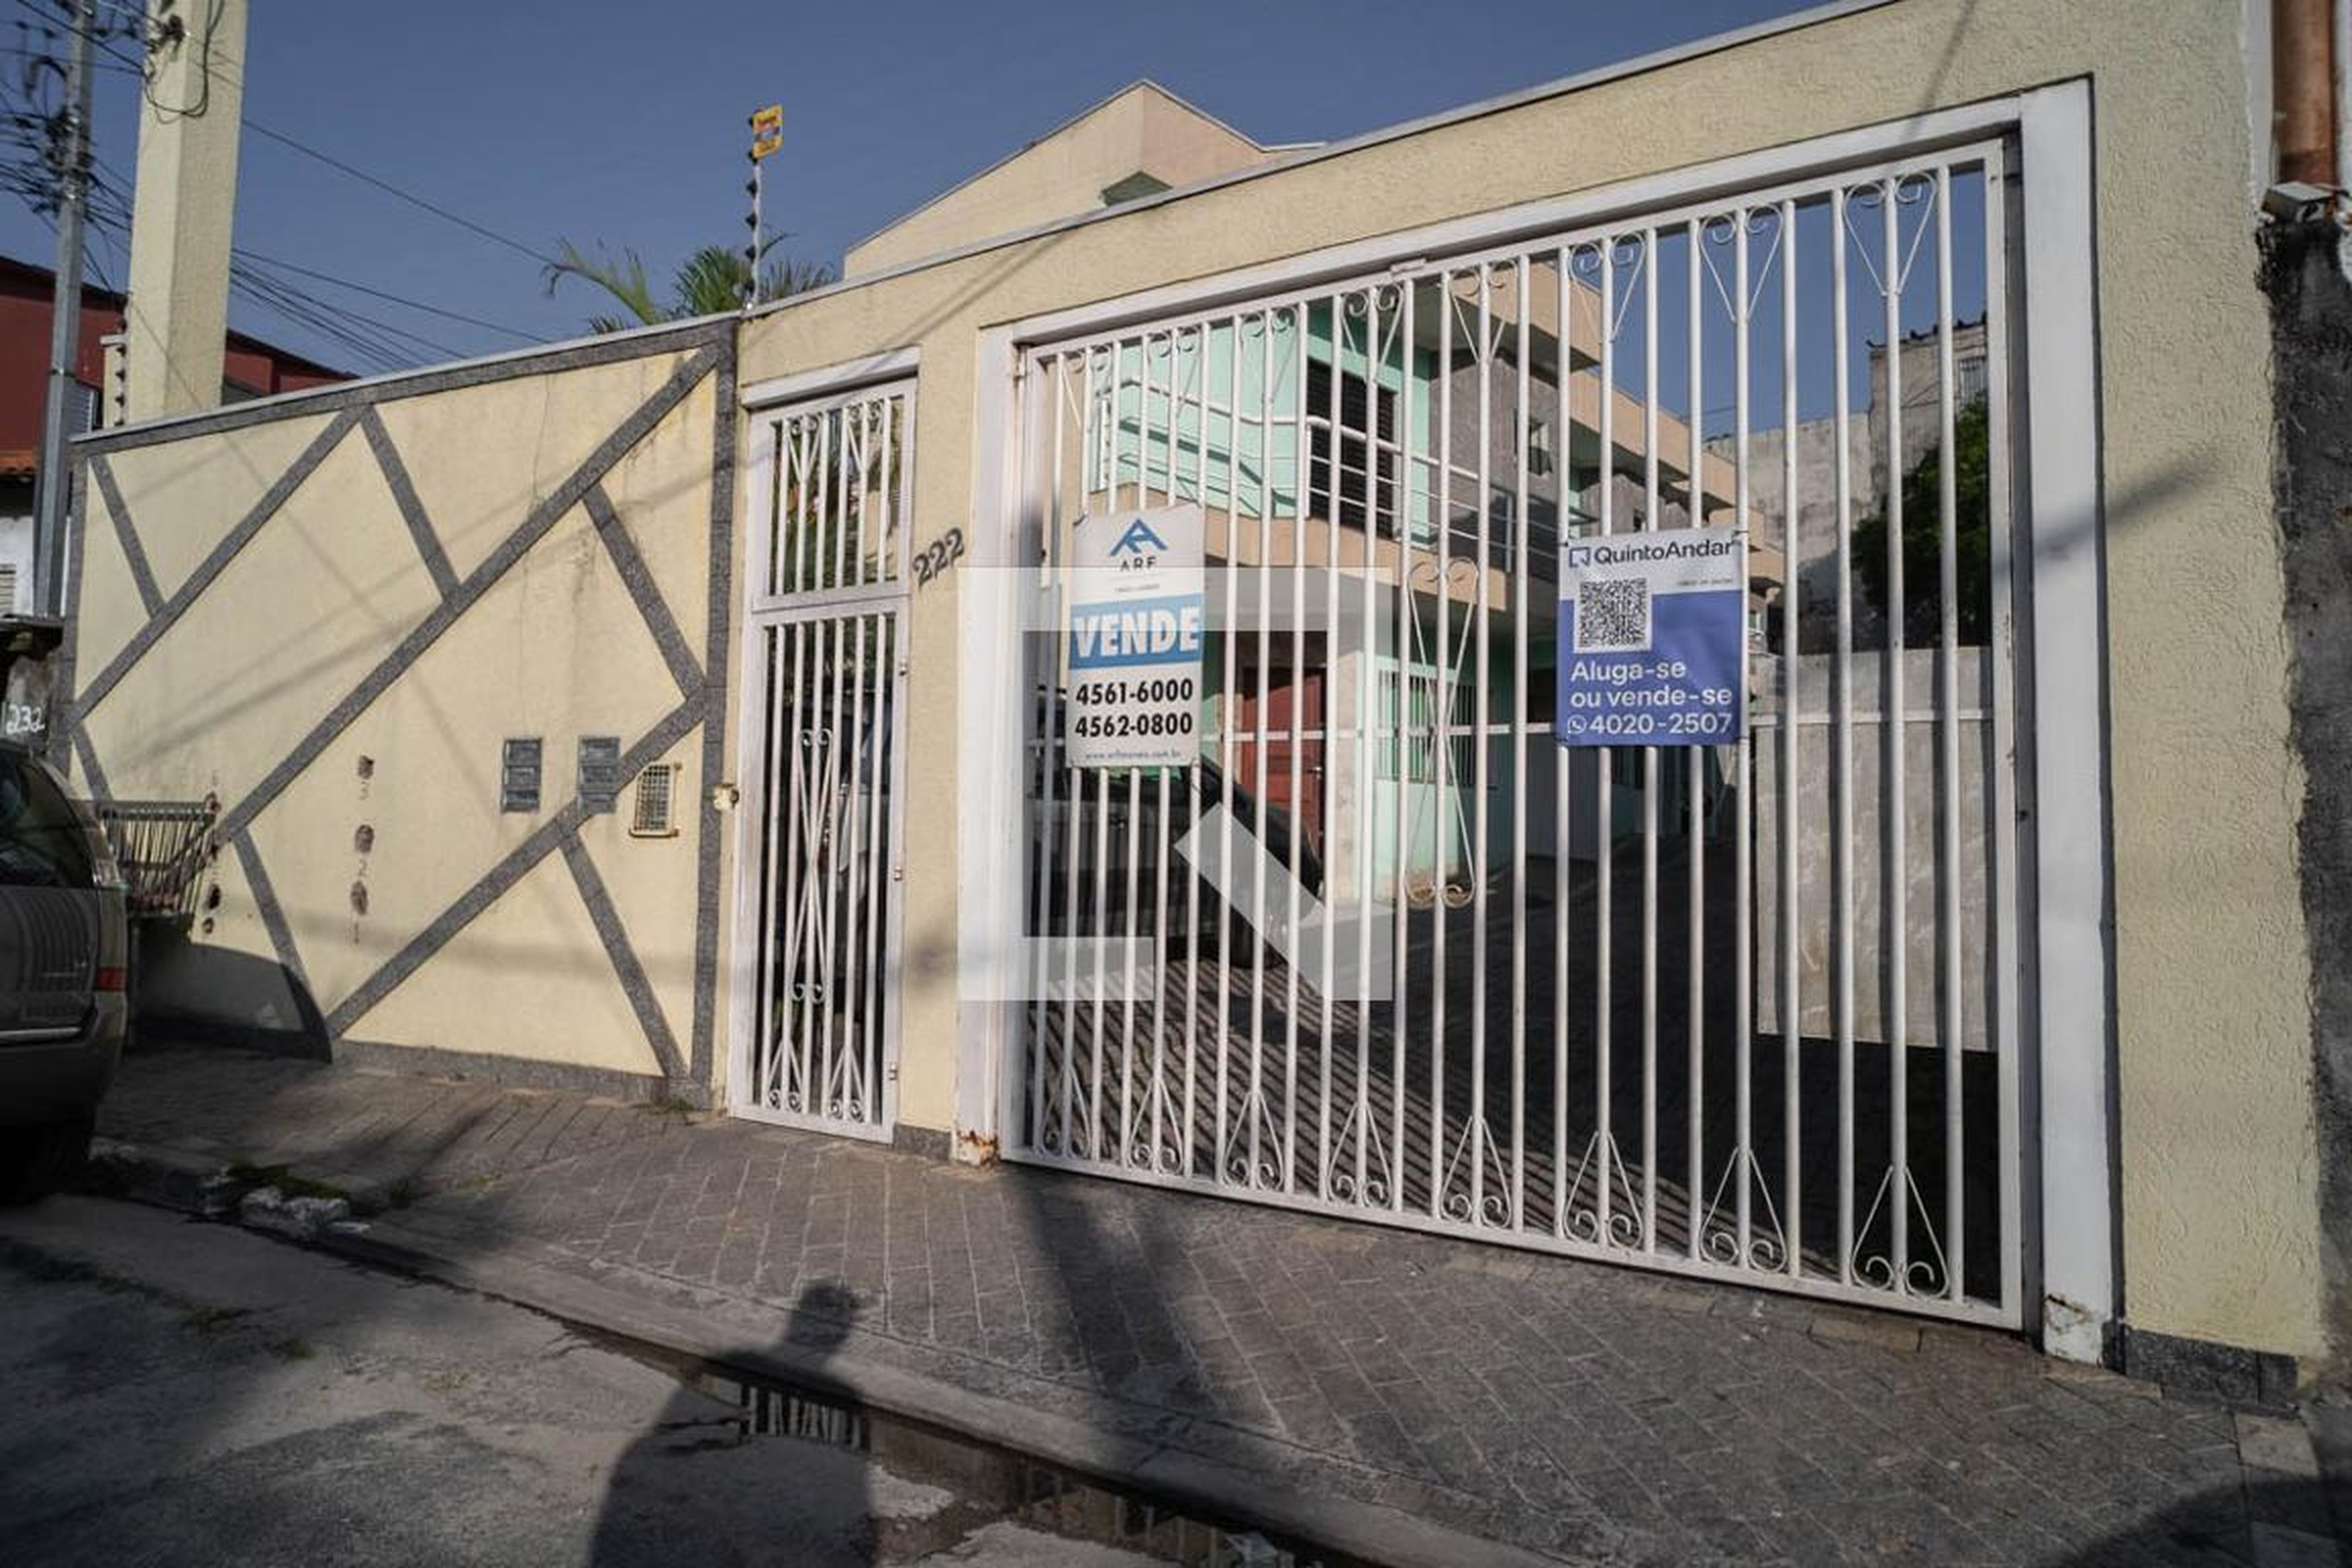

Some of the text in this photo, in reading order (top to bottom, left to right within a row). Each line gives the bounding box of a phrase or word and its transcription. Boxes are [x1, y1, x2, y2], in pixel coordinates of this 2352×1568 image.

[913, 527, 965, 590] 222
[1120, 556, 1156, 571] ARF
[1594, 539, 1732, 565] QuintoAndar
[1073, 606, 1200, 658] VENDE
[1570, 660, 1686, 685] Aluga-se
[1076, 678, 1193, 706] 4561-6000
[1570, 685, 1733, 707] ou vende-se
[1075, 712, 1193, 739] 4562-0800
[1589, 712, 1733, 734] 4020-2507
